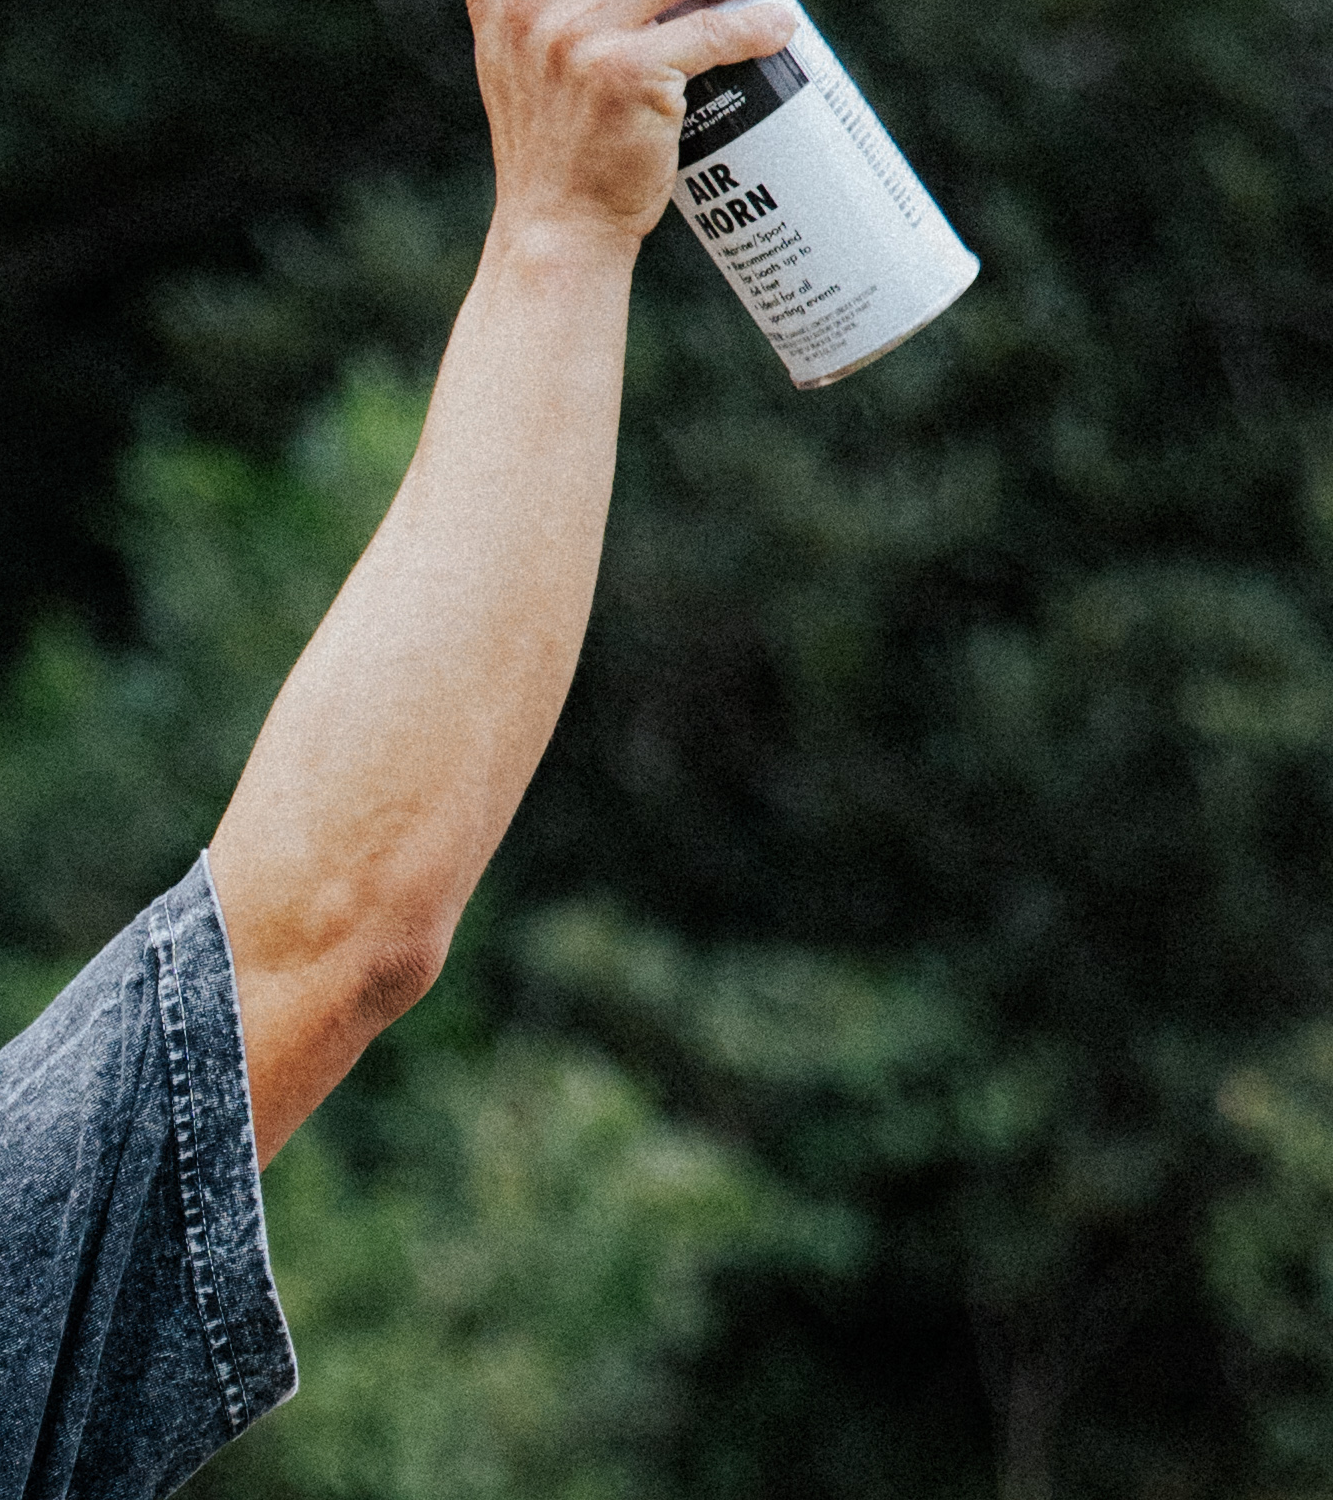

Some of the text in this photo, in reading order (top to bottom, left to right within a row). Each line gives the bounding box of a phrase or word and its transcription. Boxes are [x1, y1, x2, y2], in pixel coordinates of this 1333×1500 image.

[685, 163, 740, 206] AIR
[694, 183, 778, 240] HORN
[731, 229, 802, 271] Recommended
[782, 254, 798, 266] up
[798, 245, 812, 257] to
[779, 291, 796, 303] for
[798, 278, 813, 295] all
[806, 283, 841, 307] events
